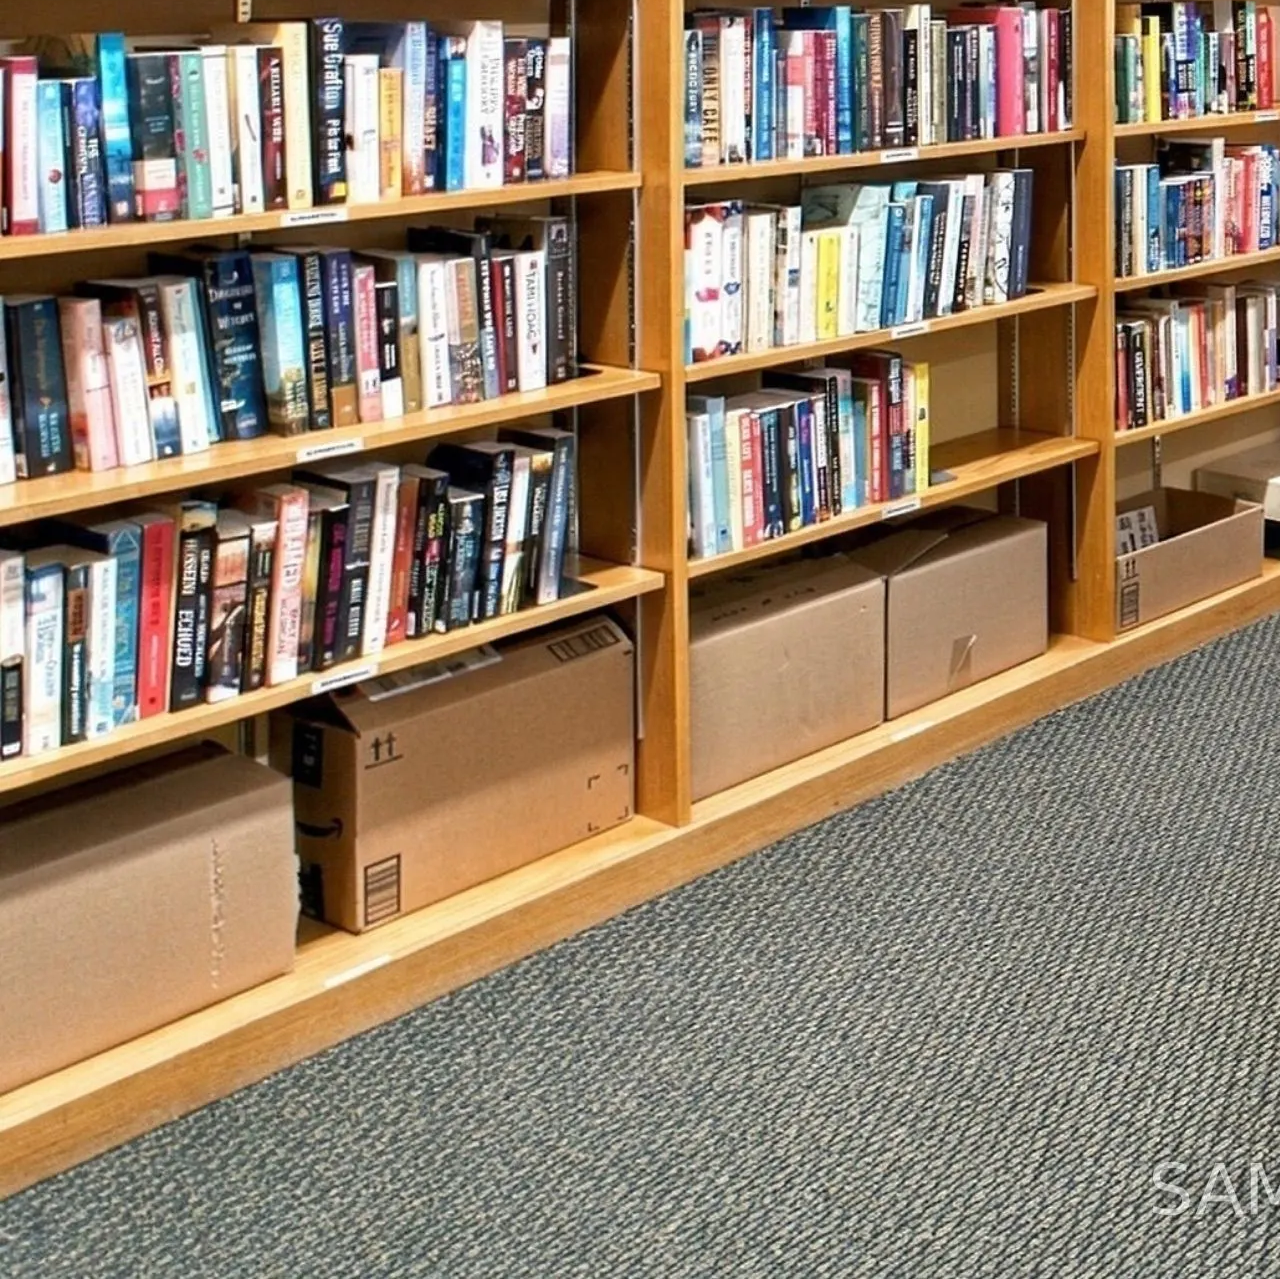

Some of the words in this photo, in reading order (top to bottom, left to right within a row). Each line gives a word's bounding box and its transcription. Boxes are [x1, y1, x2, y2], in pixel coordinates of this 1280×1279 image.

[323, 23, 343, 50] Sue
[323, 52, 344, 110] Grafton
[702, 67, 719, 102] ONLY
[702, 108, 719, 143] CAFE
[525, 271, 537, 300] TAMI
[182, 538, 198, 596] HOSSEINI
